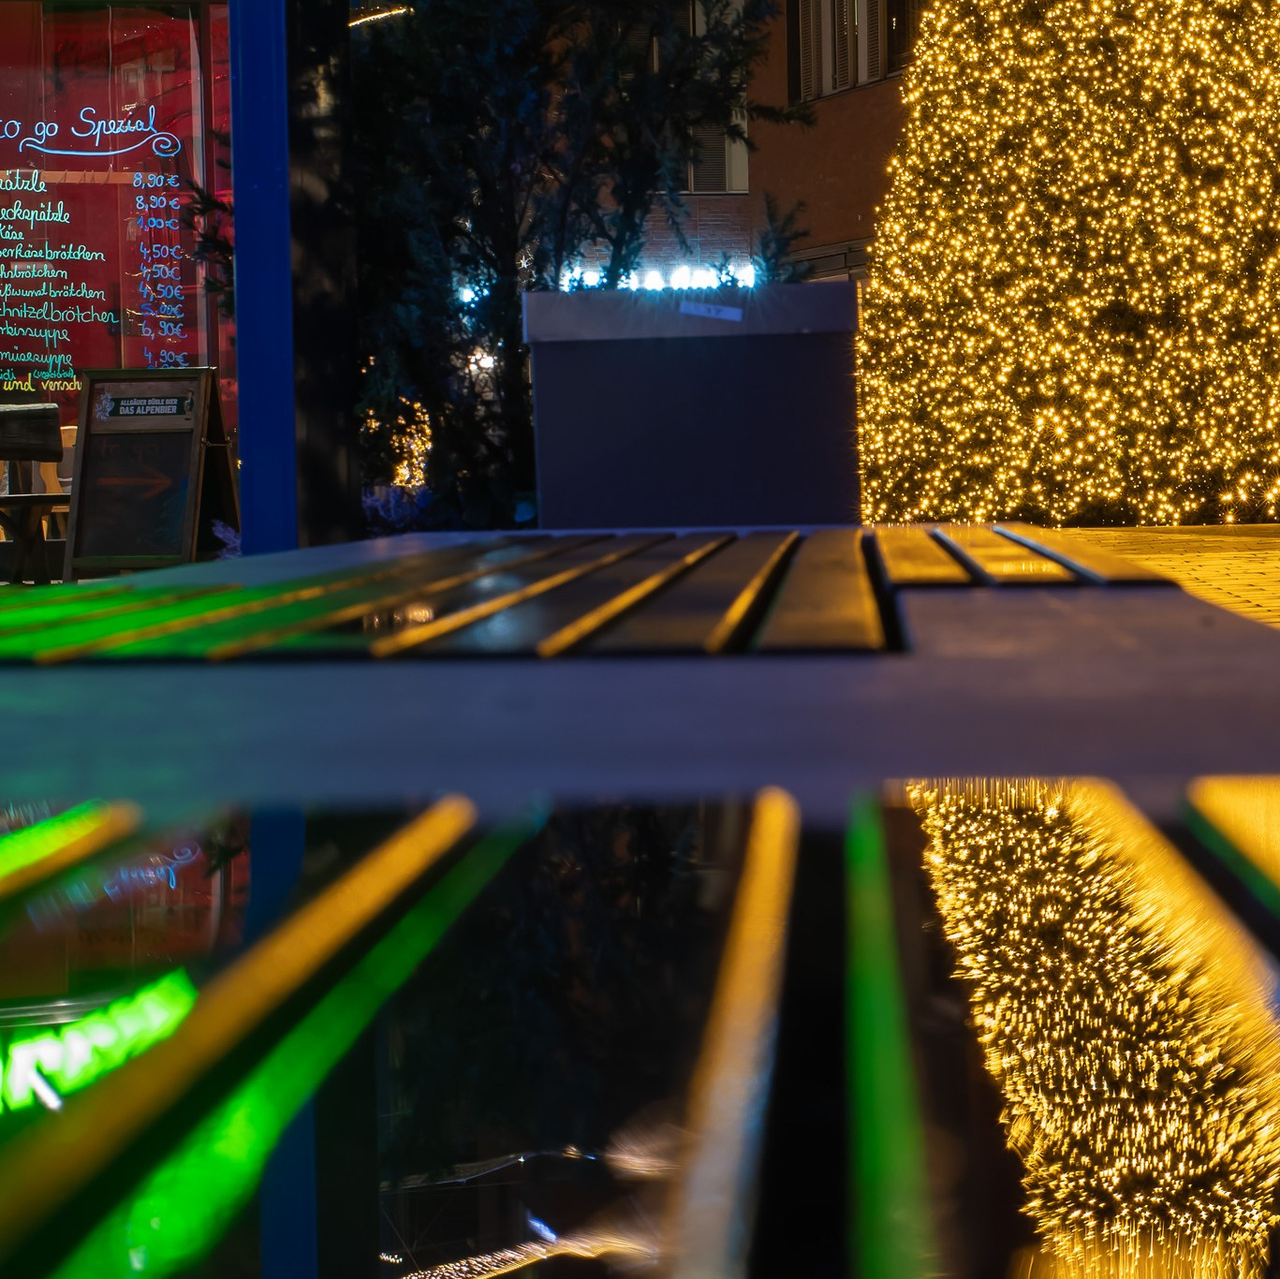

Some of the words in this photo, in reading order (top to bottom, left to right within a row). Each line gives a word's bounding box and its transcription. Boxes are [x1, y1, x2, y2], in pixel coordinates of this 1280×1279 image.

[71, 105, 157, 147] Spezial
[3, 373, 36, 392] und
[119, 406, 135, 415] DAS
[136, 405, 177, 414] ALPENBIER
